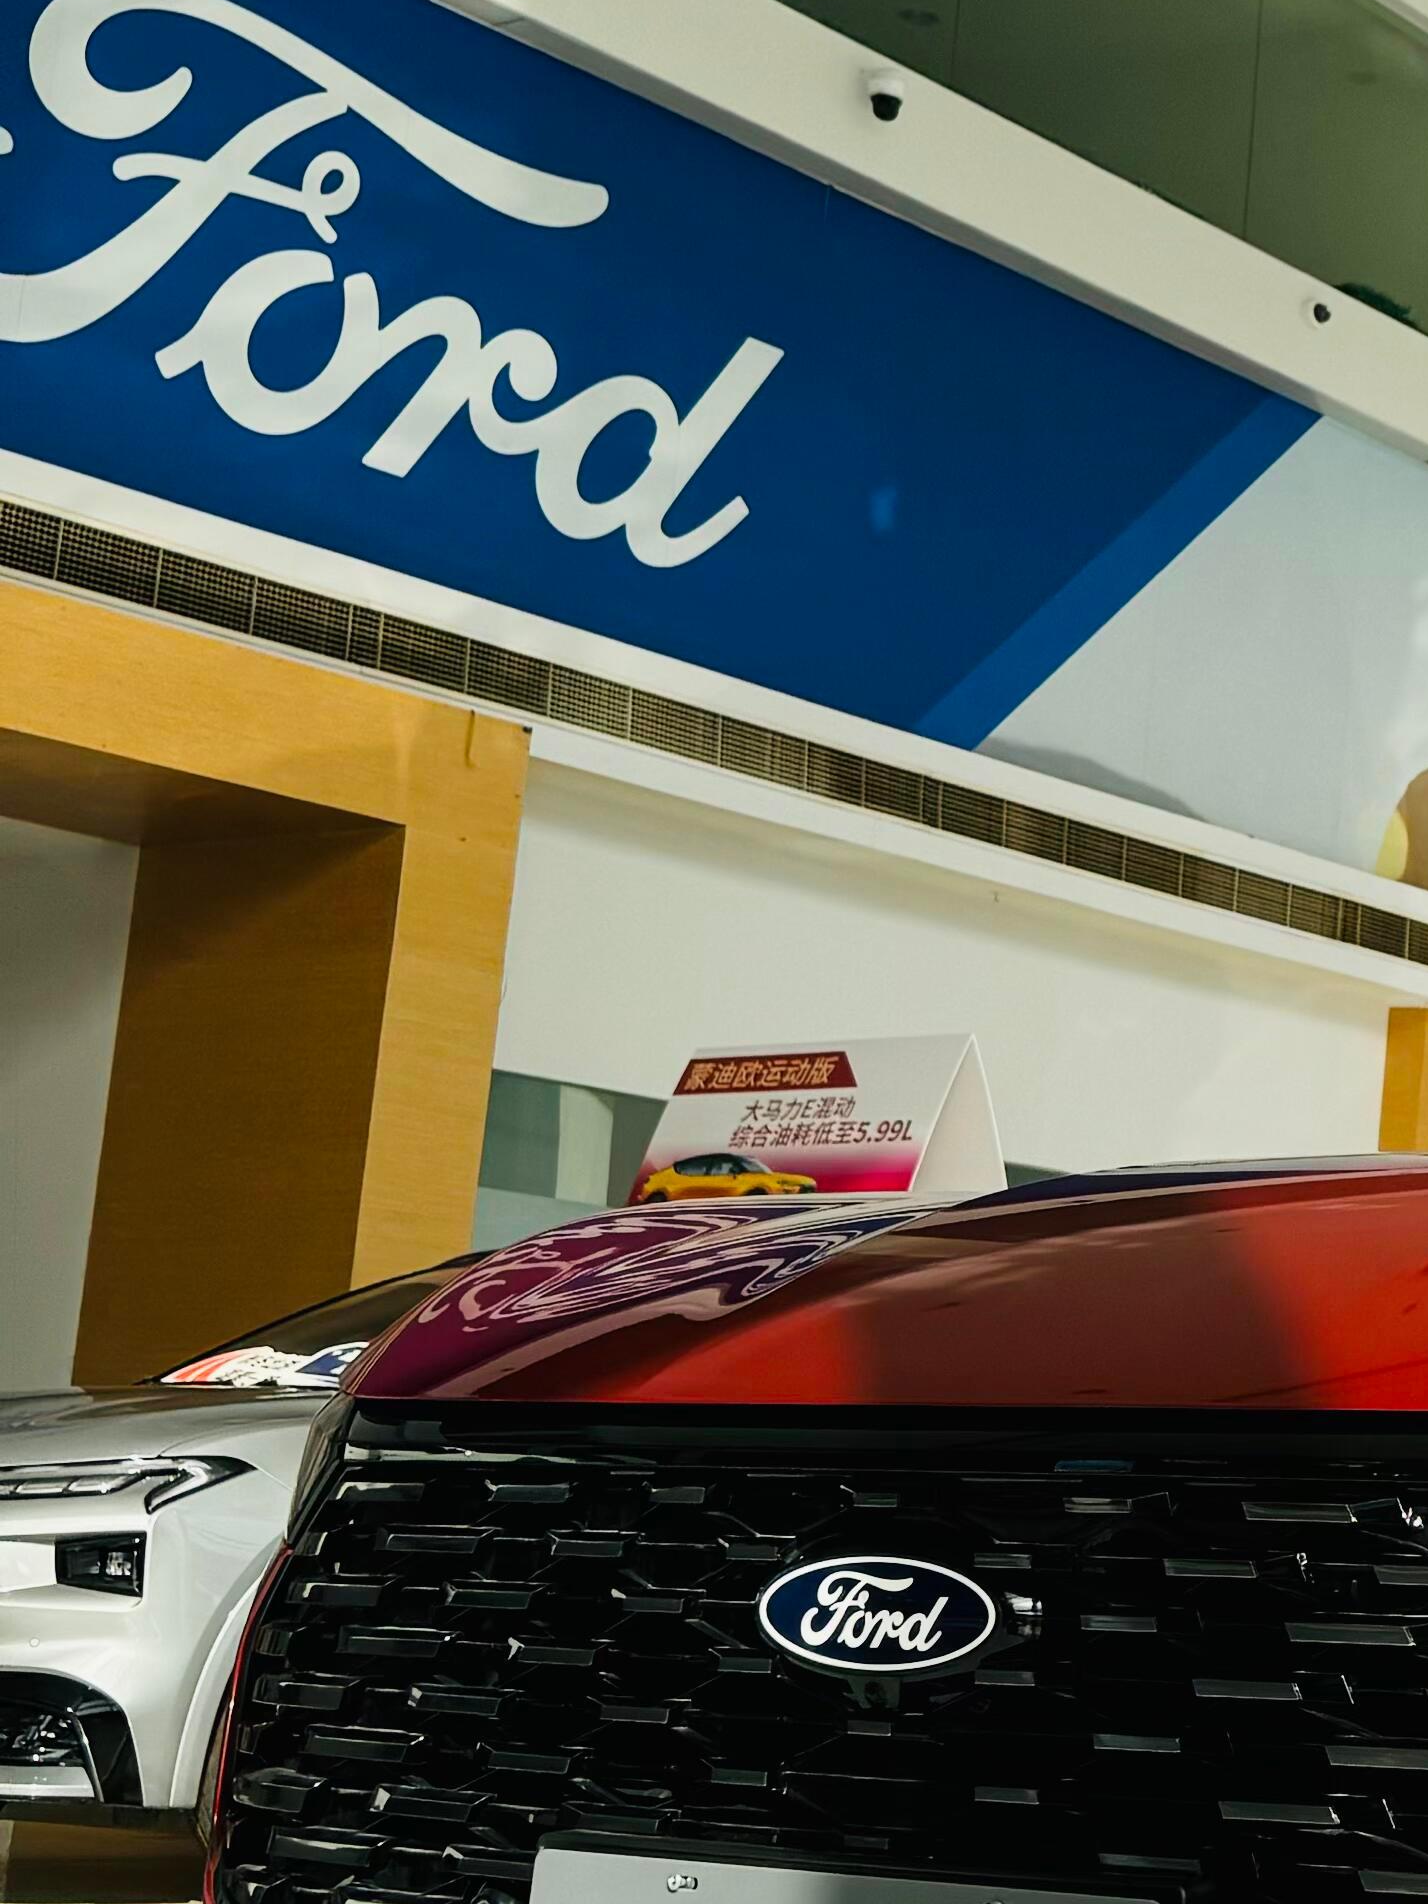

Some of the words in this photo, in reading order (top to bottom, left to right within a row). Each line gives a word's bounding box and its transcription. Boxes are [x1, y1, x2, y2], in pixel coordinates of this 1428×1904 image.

[684, 1055, 839, 1090] 蒙迪欧运动版
[740, 1096, 856, 1122] 大马力E混动
[728, 1119, 912, 1148] 综合油耗低至5.99L
[799, 1569, 949, 1653] Ford
